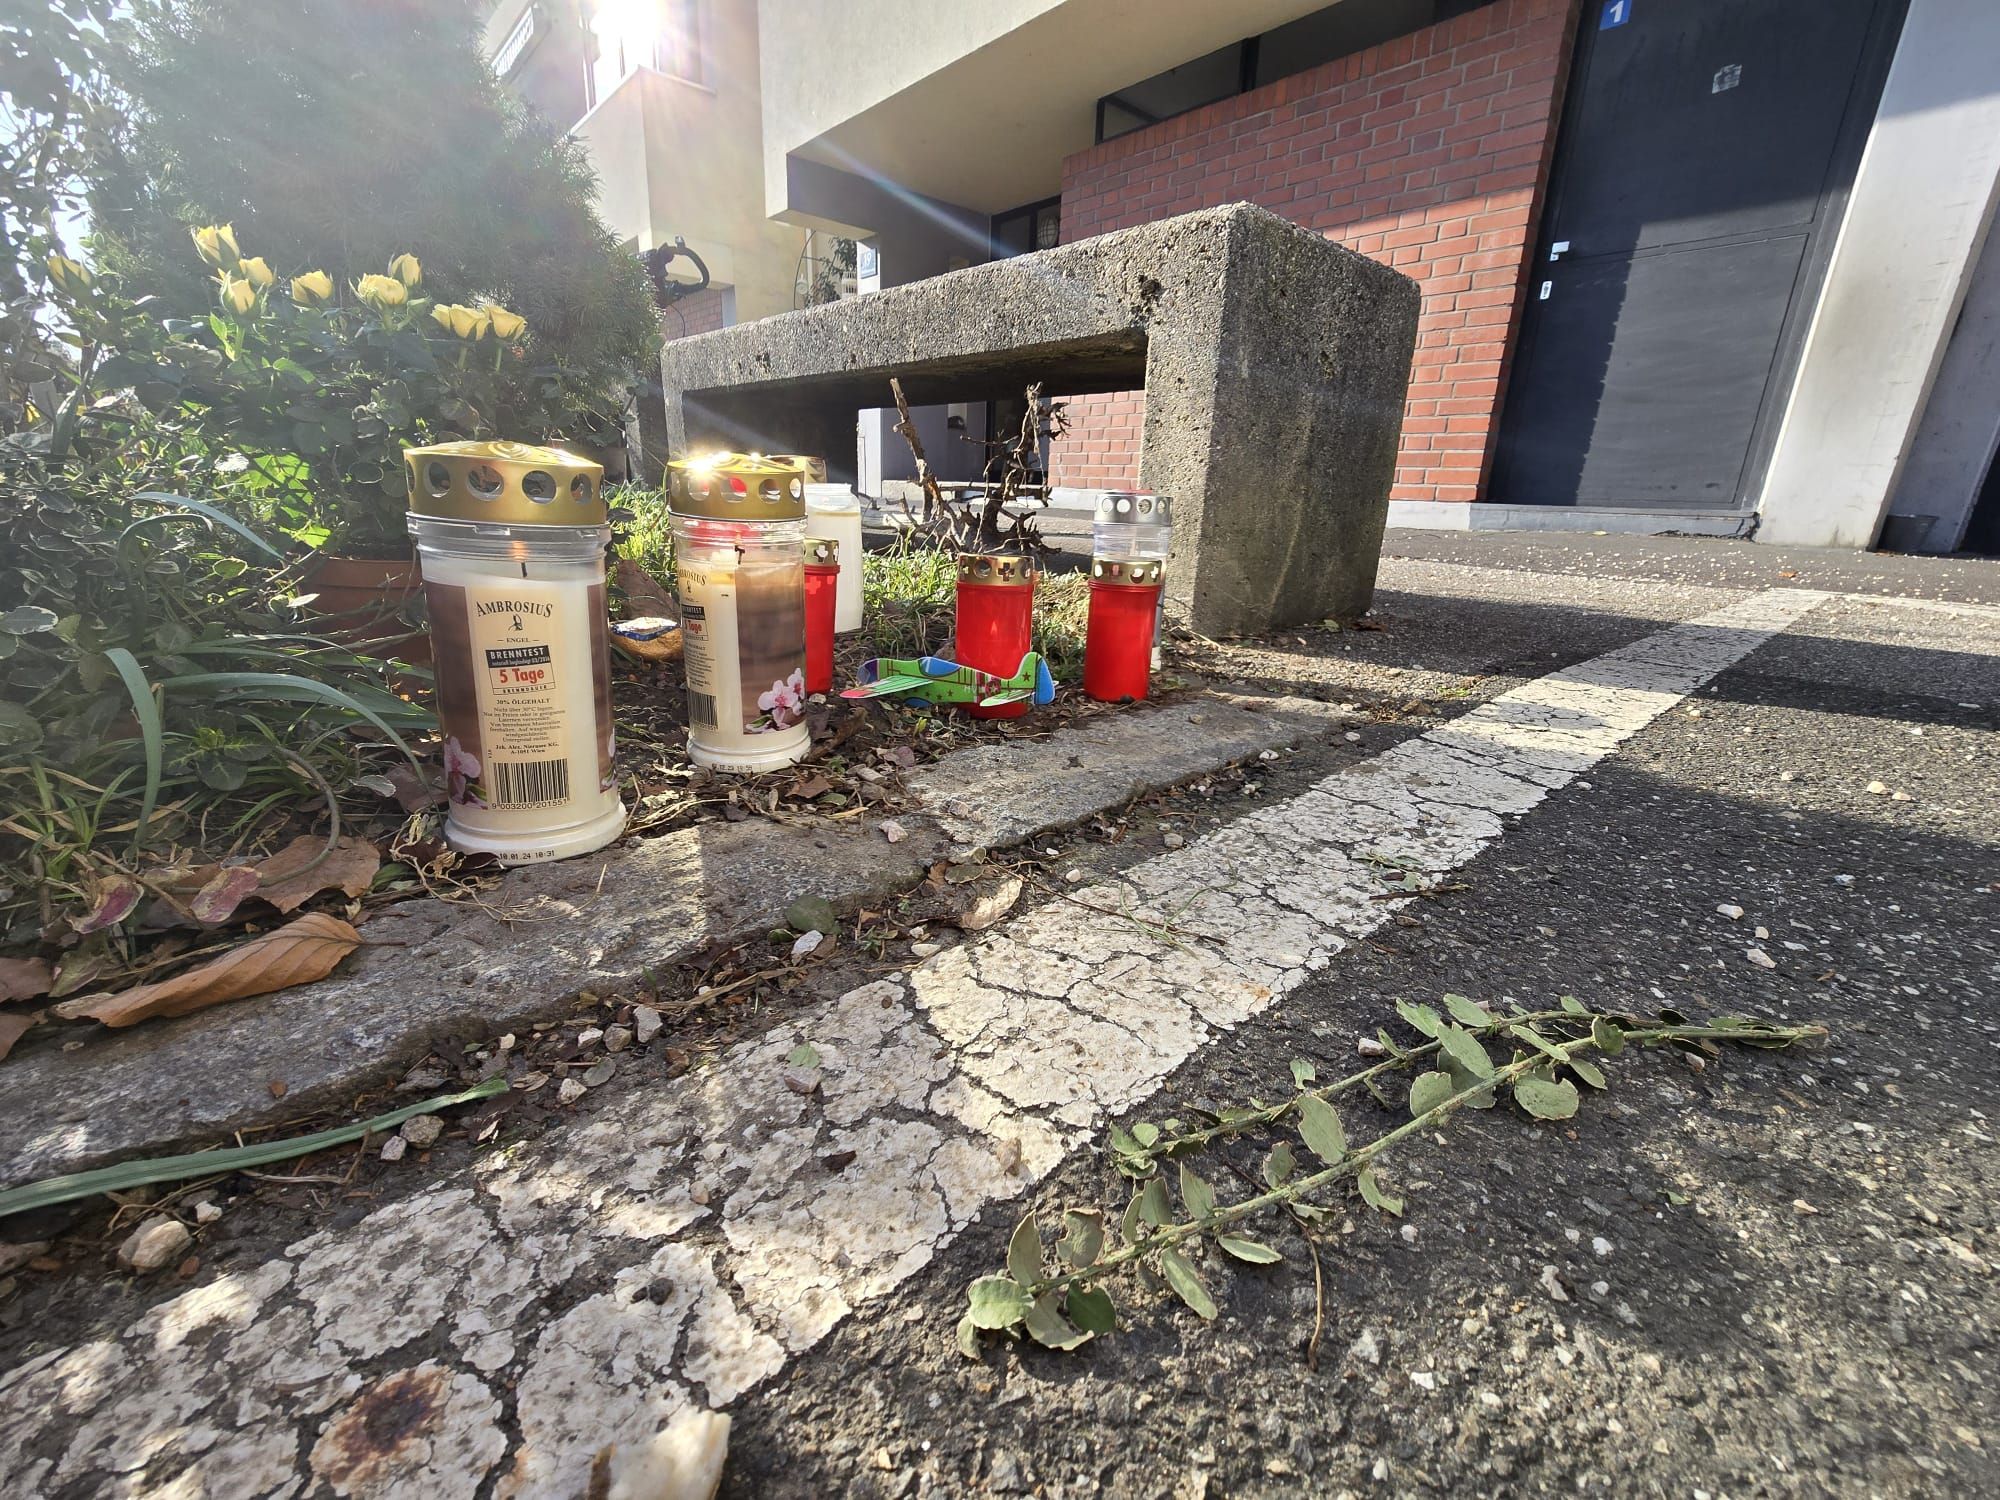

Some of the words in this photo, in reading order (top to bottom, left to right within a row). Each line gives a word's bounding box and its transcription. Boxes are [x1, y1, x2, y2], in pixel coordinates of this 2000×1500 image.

[1609, 0, 1624, 23] 1
[476, 600, 553, 618] AMBROSIUS
[490, 648, 544, 660] BRENNTEST
[500, 669, 508, 684] 5
[512, 668, 545, 684] Tage
[536, 798, 567, 809] 201551
[535, 850, 555, 858] 10:31
